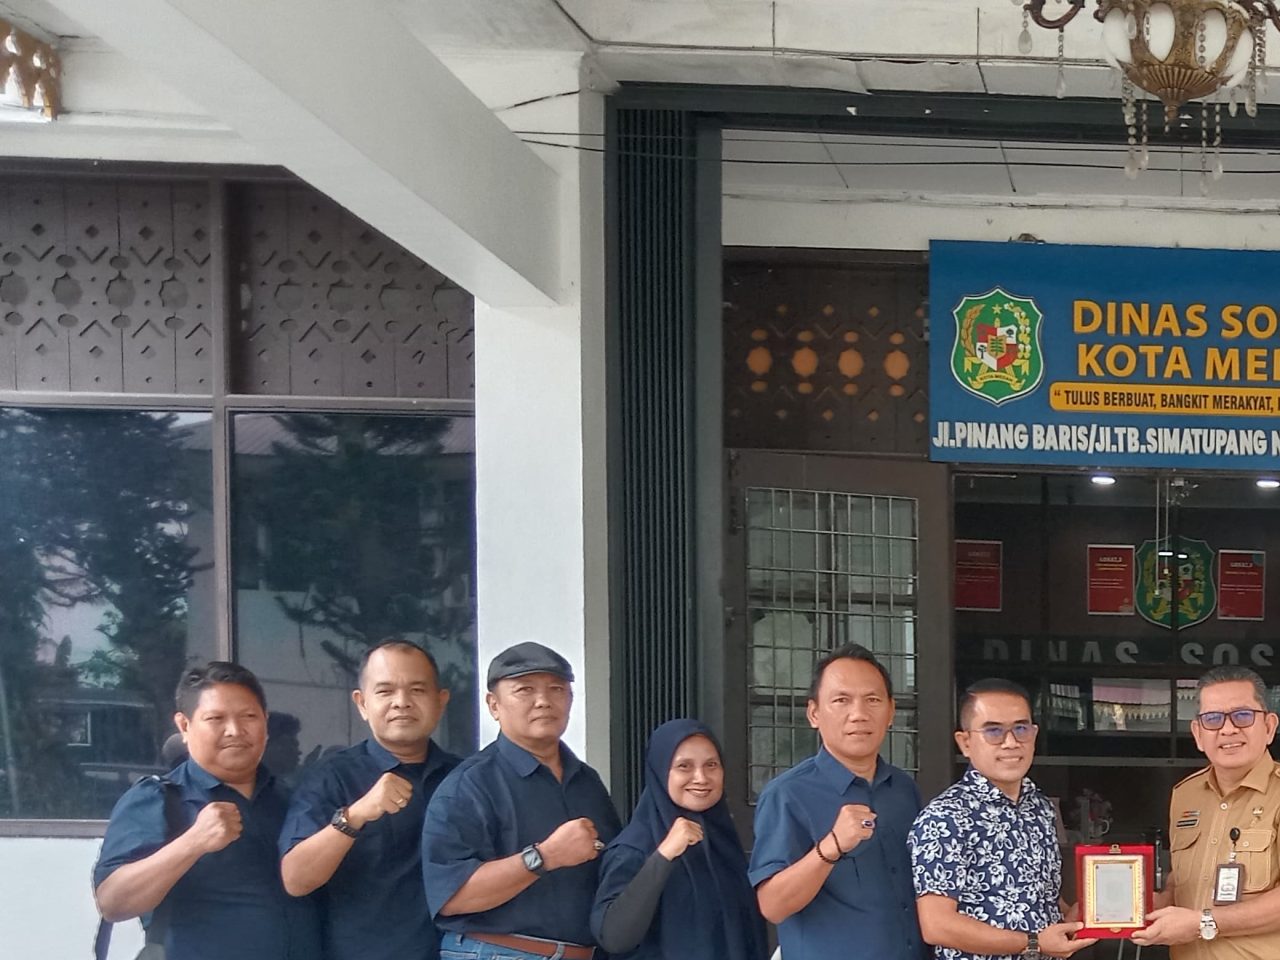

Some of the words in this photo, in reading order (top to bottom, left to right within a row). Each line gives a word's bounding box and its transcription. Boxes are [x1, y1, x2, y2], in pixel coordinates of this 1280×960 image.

[1073, 299, 1208, 337] DINAS
[1077, 343, 1192, 379] KOTA
[1064, 390, 1100, 406] TULUS
[1104, 392, 1157, 410] BERBUAT,
[1160, 393, 1209, 409] BANGKIT
[1212, 395, 1274, 413] MERAKYAT,
[983, 638, 1139, 664] DINAS
